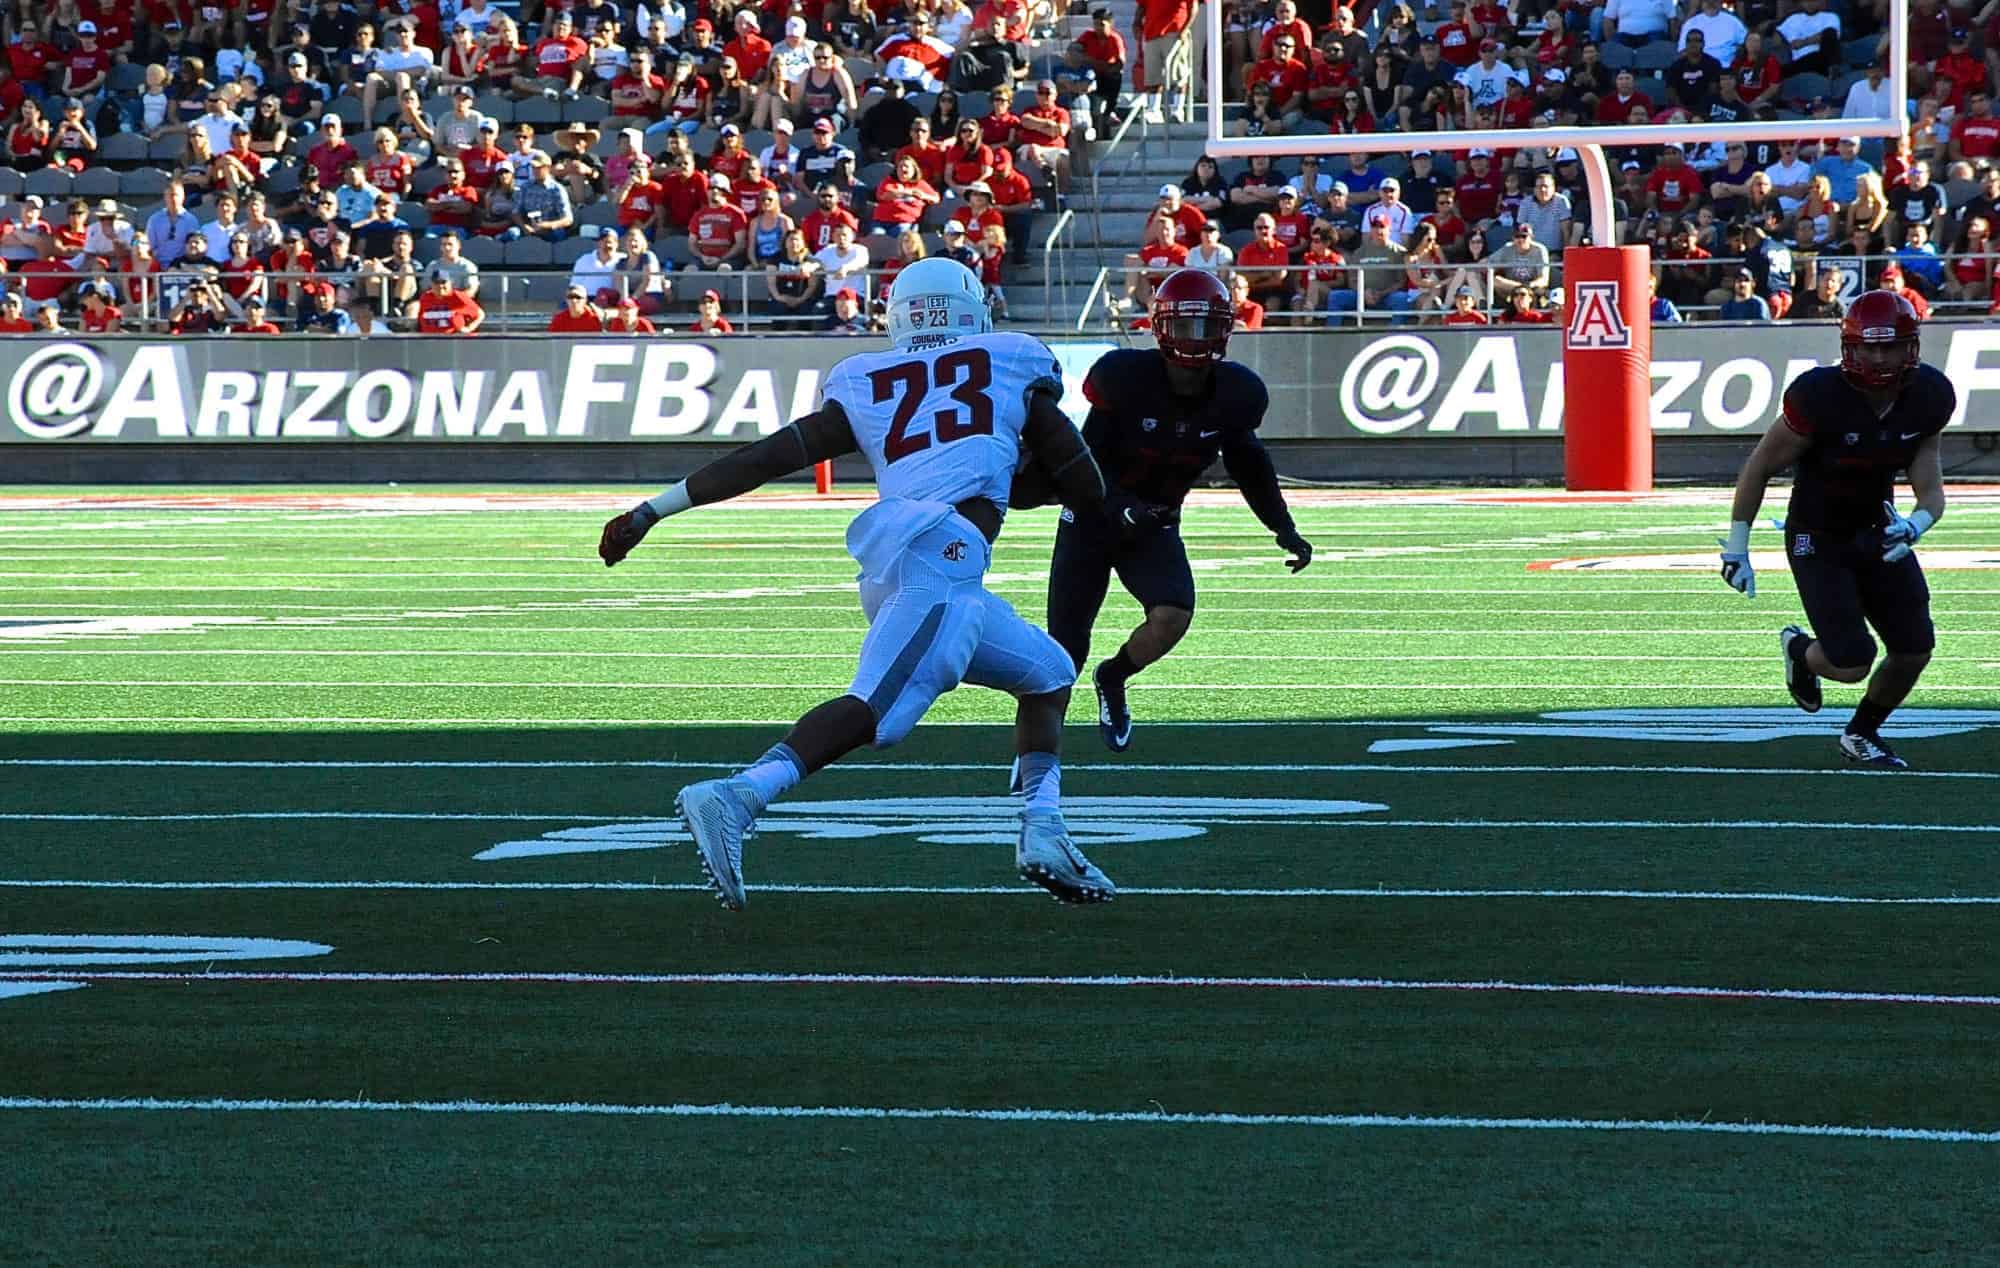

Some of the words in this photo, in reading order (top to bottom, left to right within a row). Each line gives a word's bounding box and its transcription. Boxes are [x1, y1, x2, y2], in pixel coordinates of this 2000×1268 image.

[928, 310, 948, 327] 23
[1567, 281, 1632, 350] A
[866, 348, 994, 465] 23
